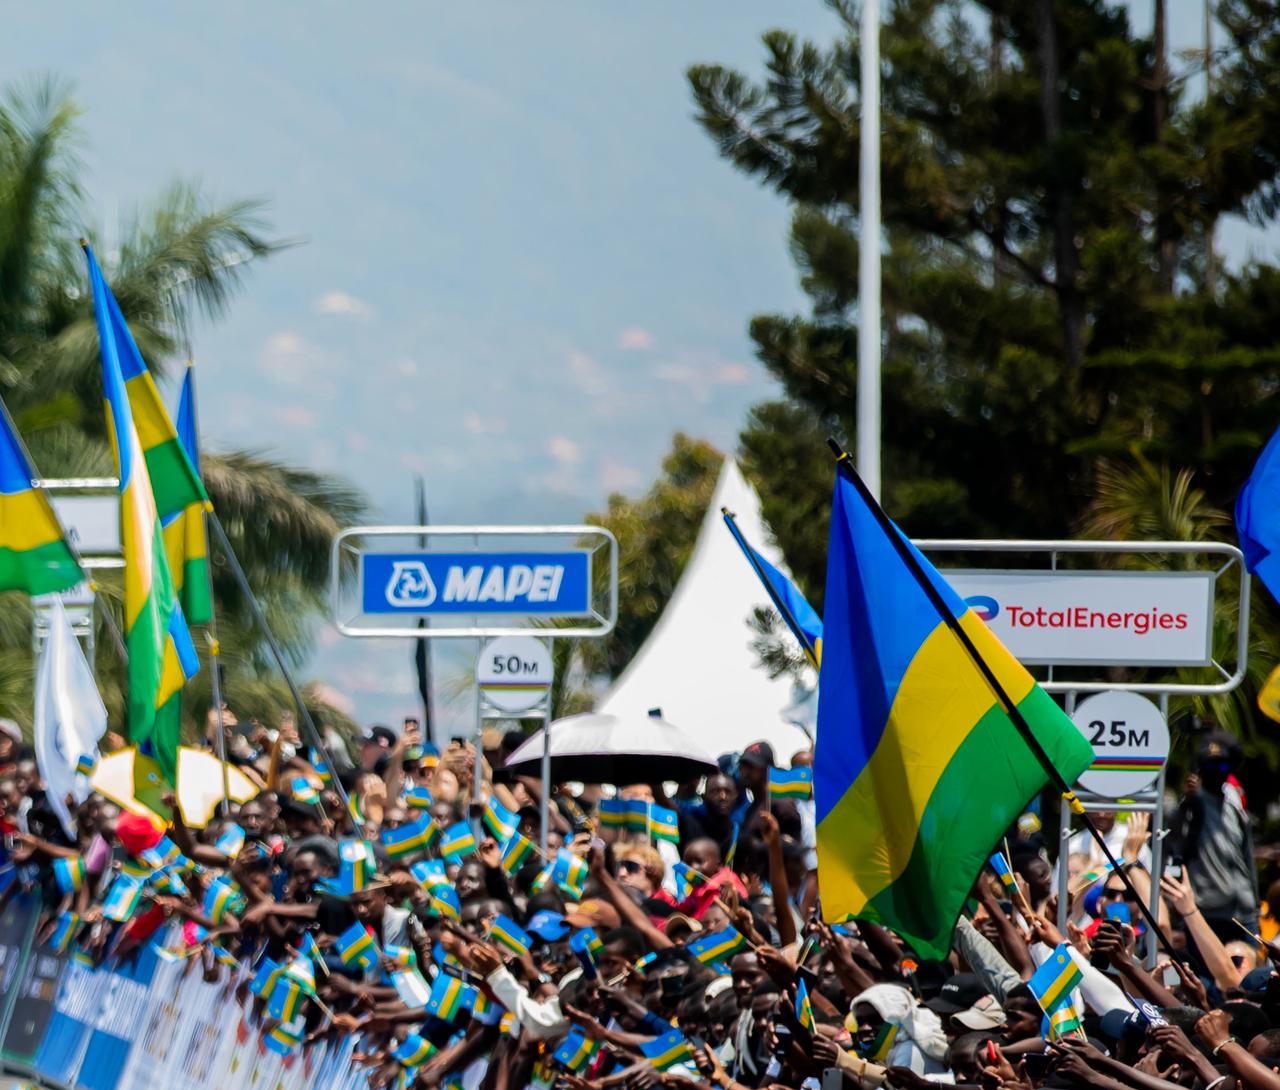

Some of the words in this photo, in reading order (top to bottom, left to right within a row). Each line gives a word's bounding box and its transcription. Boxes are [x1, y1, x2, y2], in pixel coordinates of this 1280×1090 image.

[442, 564, 565, 602] MAPEI
[1005, 606, 1189, 635] TotalEnergies
[492, 655, 539, 675] 50M
[1088, 720, 1149, 747] 25M
